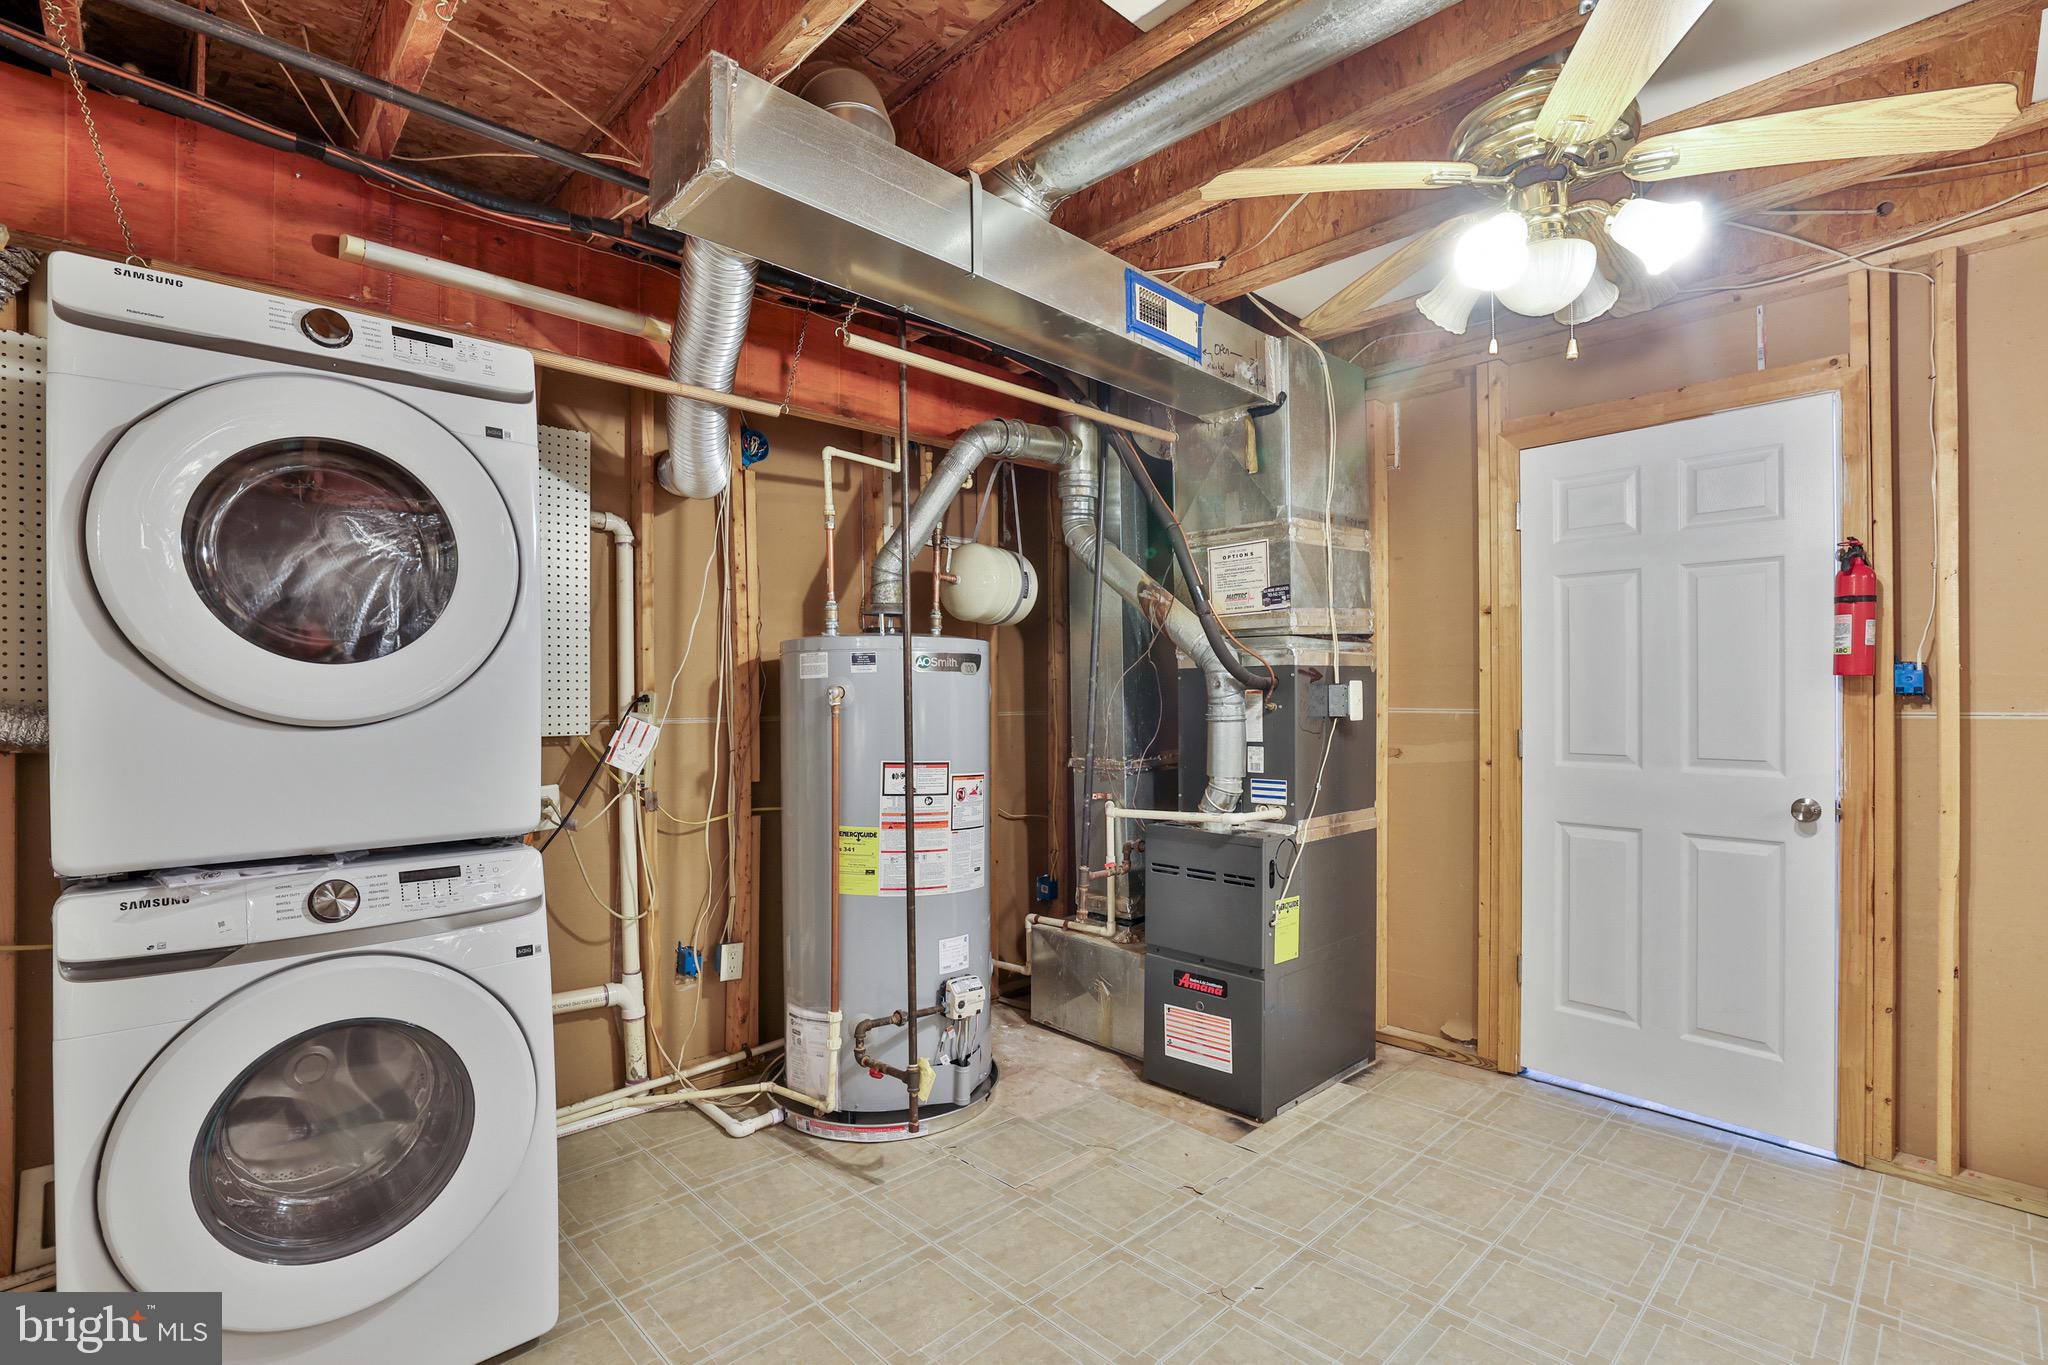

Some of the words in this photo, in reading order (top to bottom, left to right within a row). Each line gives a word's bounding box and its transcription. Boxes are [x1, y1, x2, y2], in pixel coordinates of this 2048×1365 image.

[113, 267, 184, 288] SAMSUNG
[1222, 551, 1254, 560] OPTIONS
[119, 895, 190, 911] SAMSUNG
[1178, 972, 1224, 996] Amana
